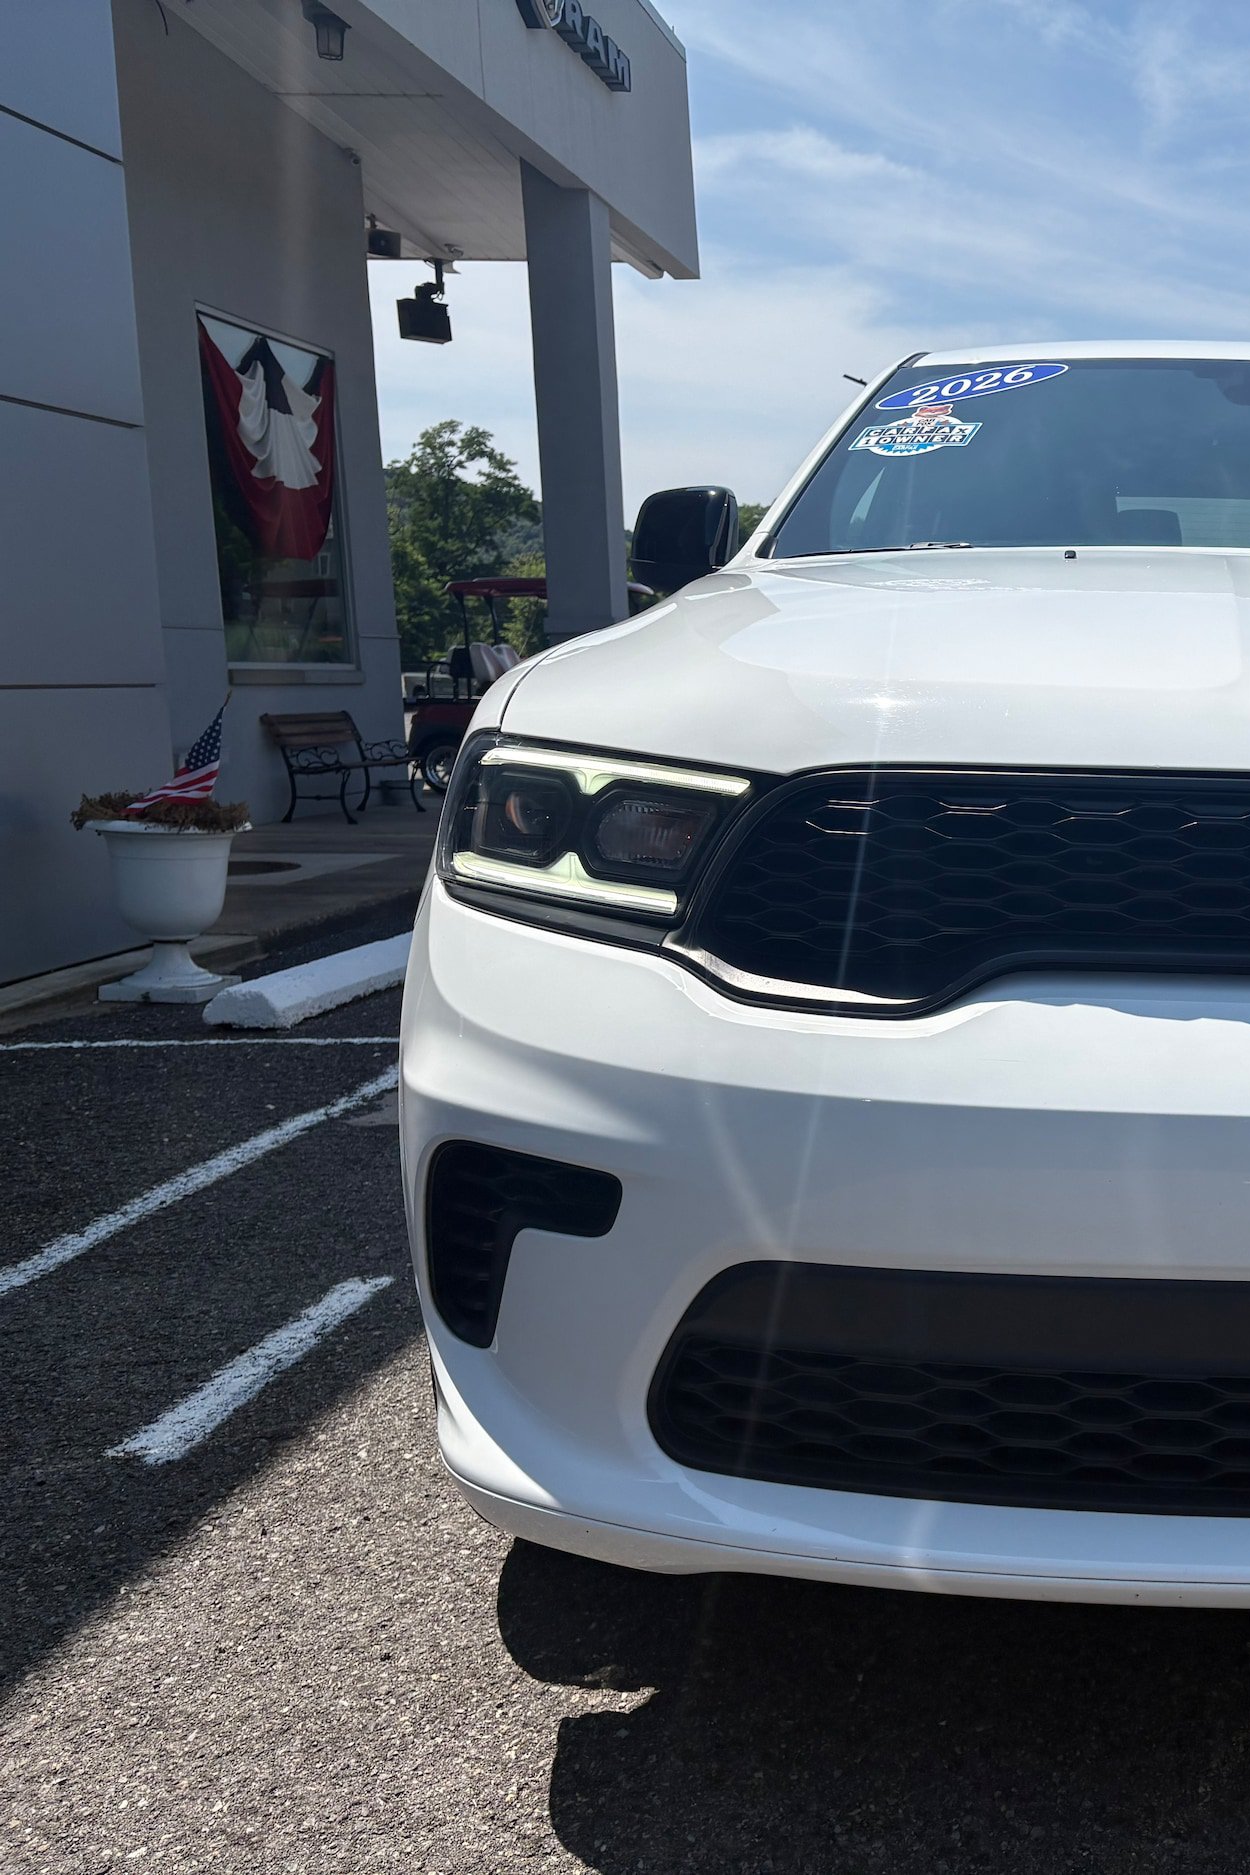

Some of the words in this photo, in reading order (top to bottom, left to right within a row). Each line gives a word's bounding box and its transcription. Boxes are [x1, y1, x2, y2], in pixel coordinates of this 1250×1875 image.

[563, 0, 631, 92] RAM
[908, 365, 1036, 406] 2026
[868, 426, 970, 437] CARFAX
[878, 435, 963, 445] OWNER
